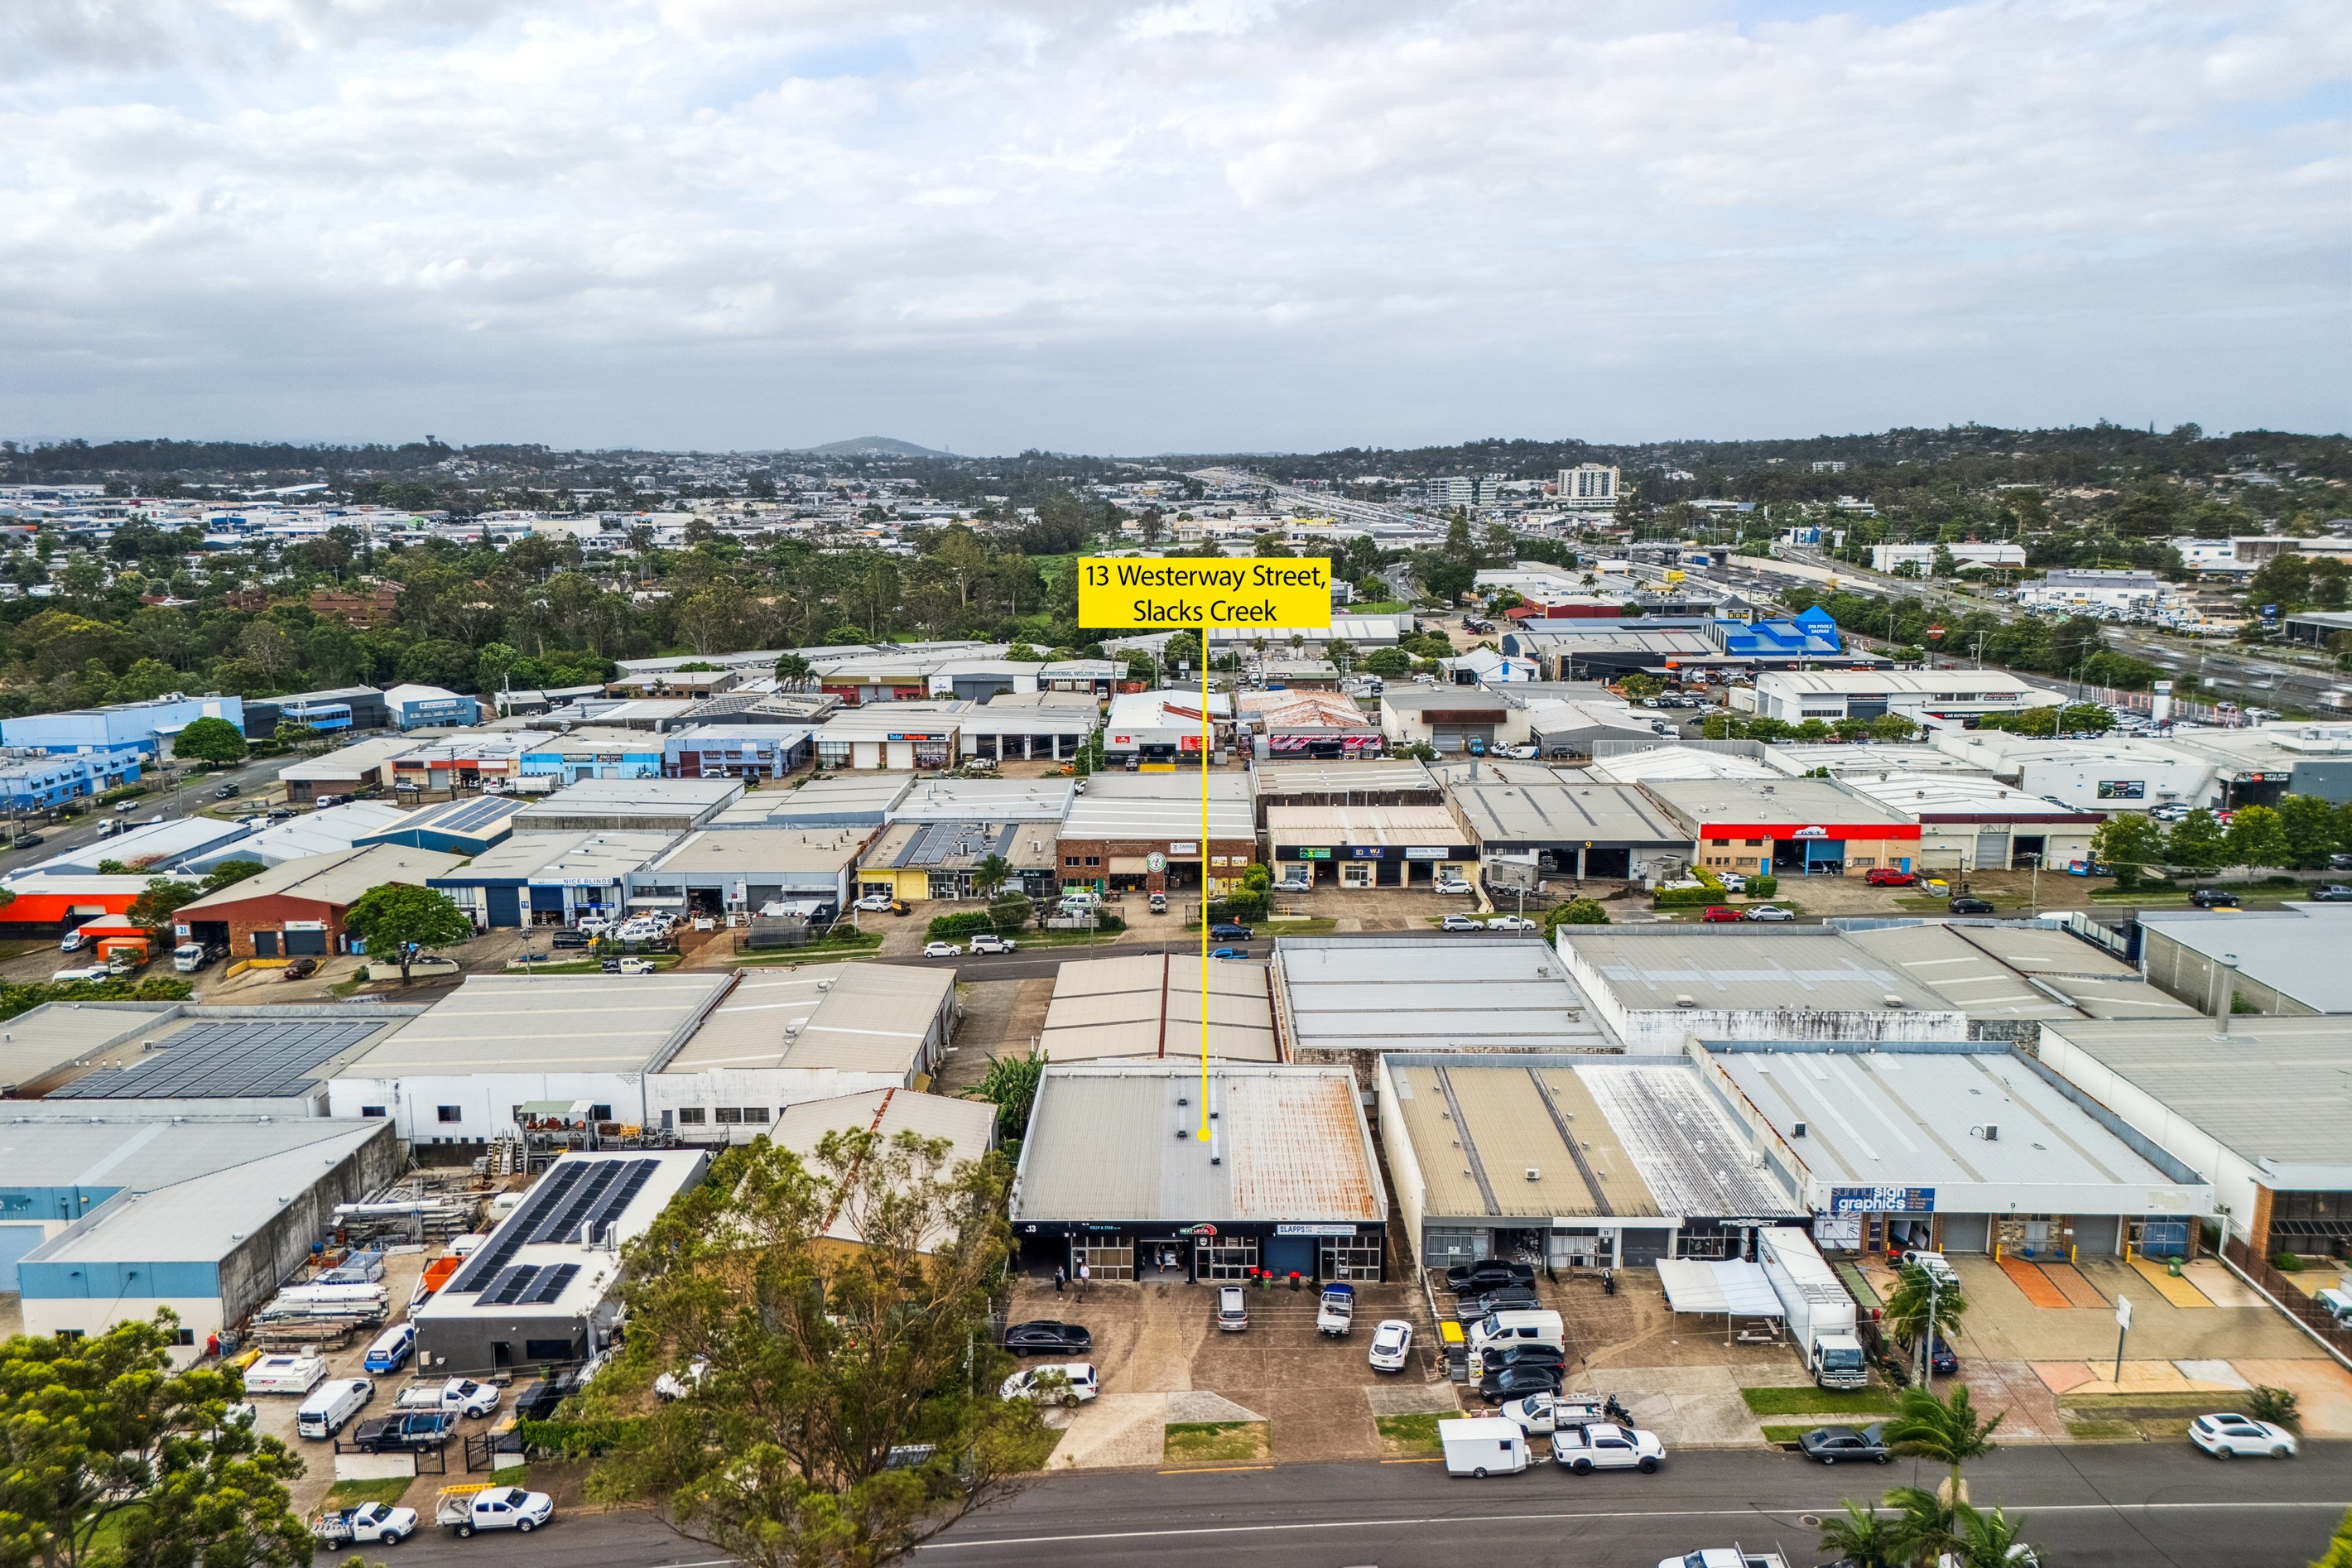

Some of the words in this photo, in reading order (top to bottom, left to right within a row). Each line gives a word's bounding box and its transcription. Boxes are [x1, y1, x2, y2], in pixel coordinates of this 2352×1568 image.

[1585, 840, 1592, 849] 9
[180, 926, 186, 935] 21
[1831, 1188, 1872, 1200] sunny
[1873, 1187, 1906, 1200] sign
[1839, 1195, 1906, 1211] graphics
